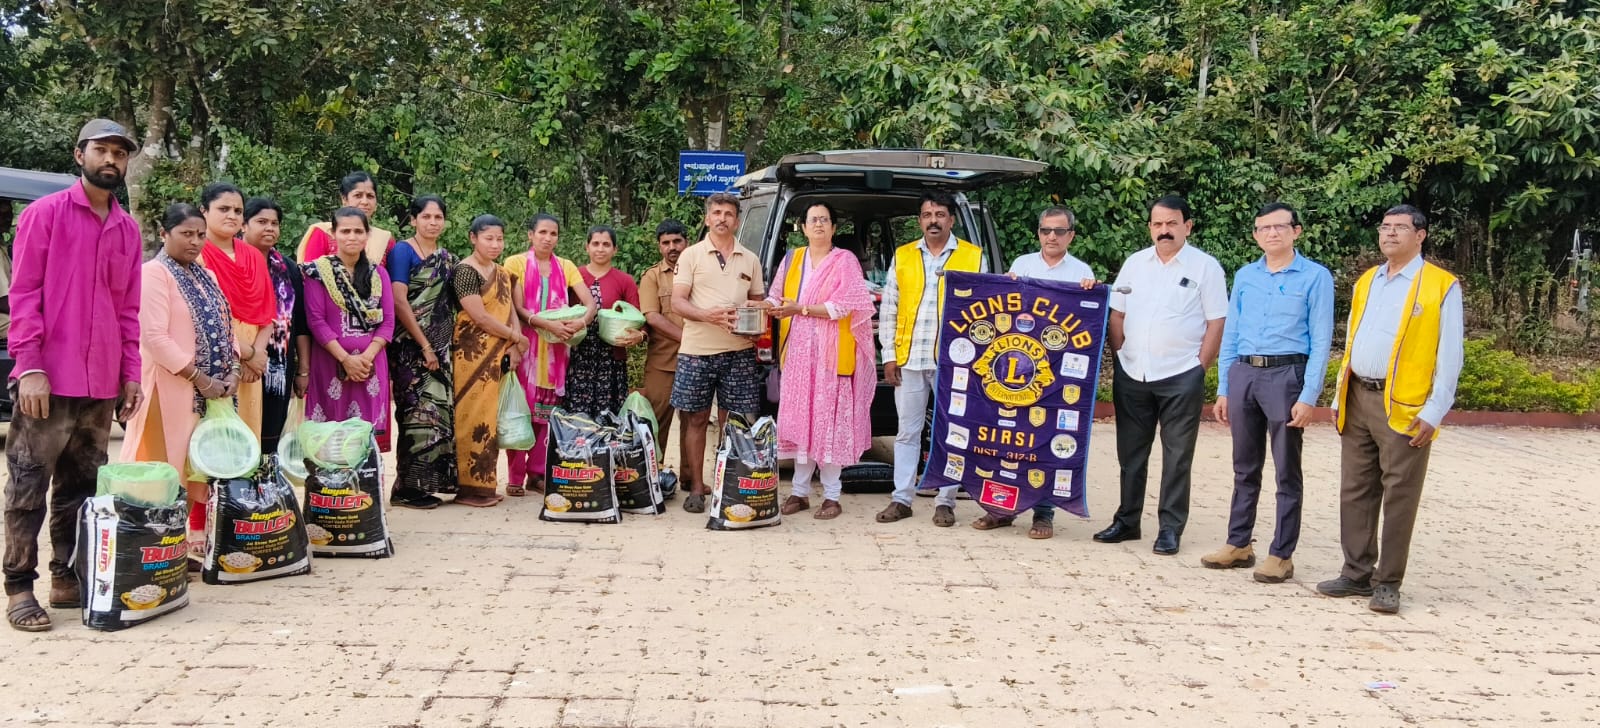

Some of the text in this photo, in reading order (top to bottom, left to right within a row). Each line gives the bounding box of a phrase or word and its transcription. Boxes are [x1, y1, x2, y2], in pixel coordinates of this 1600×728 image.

[949, 292, 1022, 334] LIONS
[1032, 297, 1092, 349] CLUB
[999, 336, 1042, 358] LIONS
[1006, 357, 1025, 384] L
[977, 426, 1035, 448] SIRSI
[552, 465, 603, 480] BULLET
[560, 461, 584, 469] Royal
[751, 471, 774, 480] Royal
[320, 487, 350, 496] Royal
[309, 492, 371, 510] BULLET
[250, 508, 284, 520] Royal
[233, 511, 295, 534] BULLET
[161, 533, 185, 546] Roya
[140, 541, 188, 564] BULLE
[143, 561, 170, 570] BRAND
